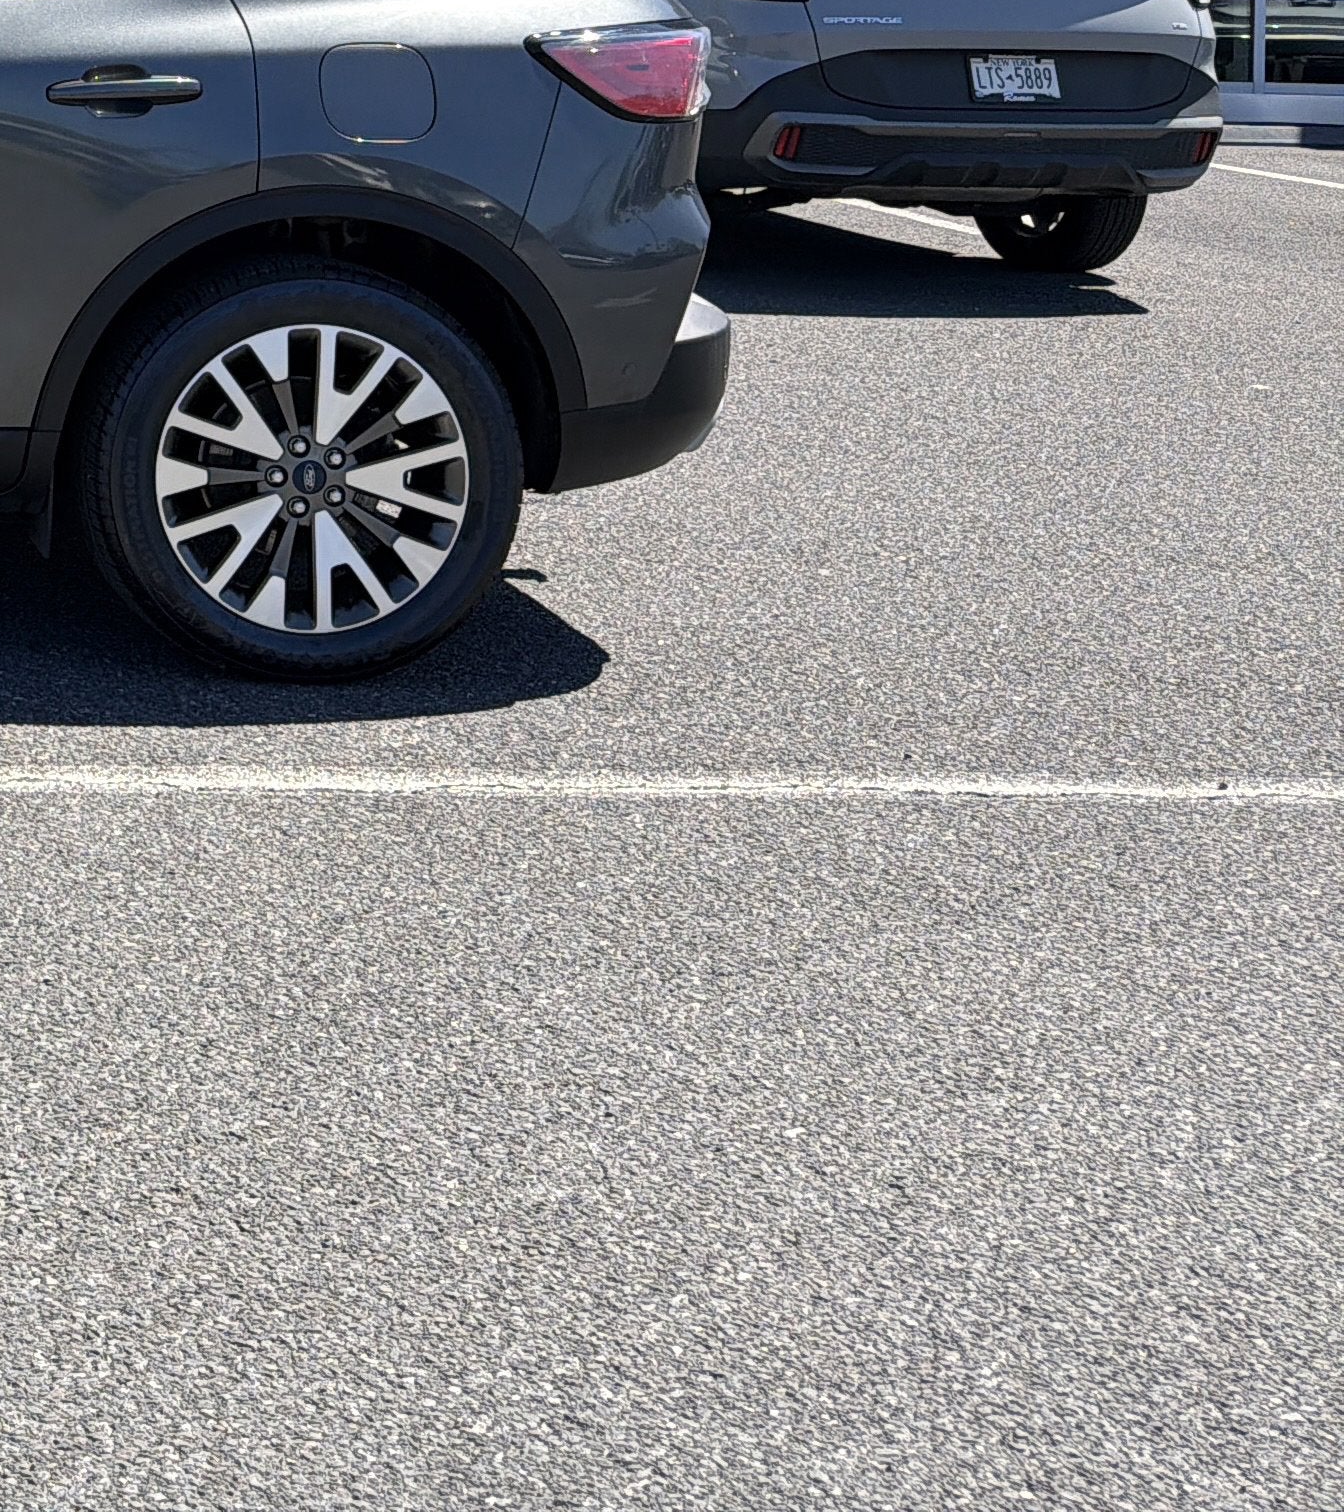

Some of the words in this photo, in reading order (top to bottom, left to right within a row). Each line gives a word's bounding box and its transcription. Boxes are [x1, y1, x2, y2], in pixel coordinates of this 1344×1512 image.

[822, 16, 903, 24] SPORTAGE
[991, 58, 1010, 67] NEW
[1012, 58, 1035, 67] YORK
